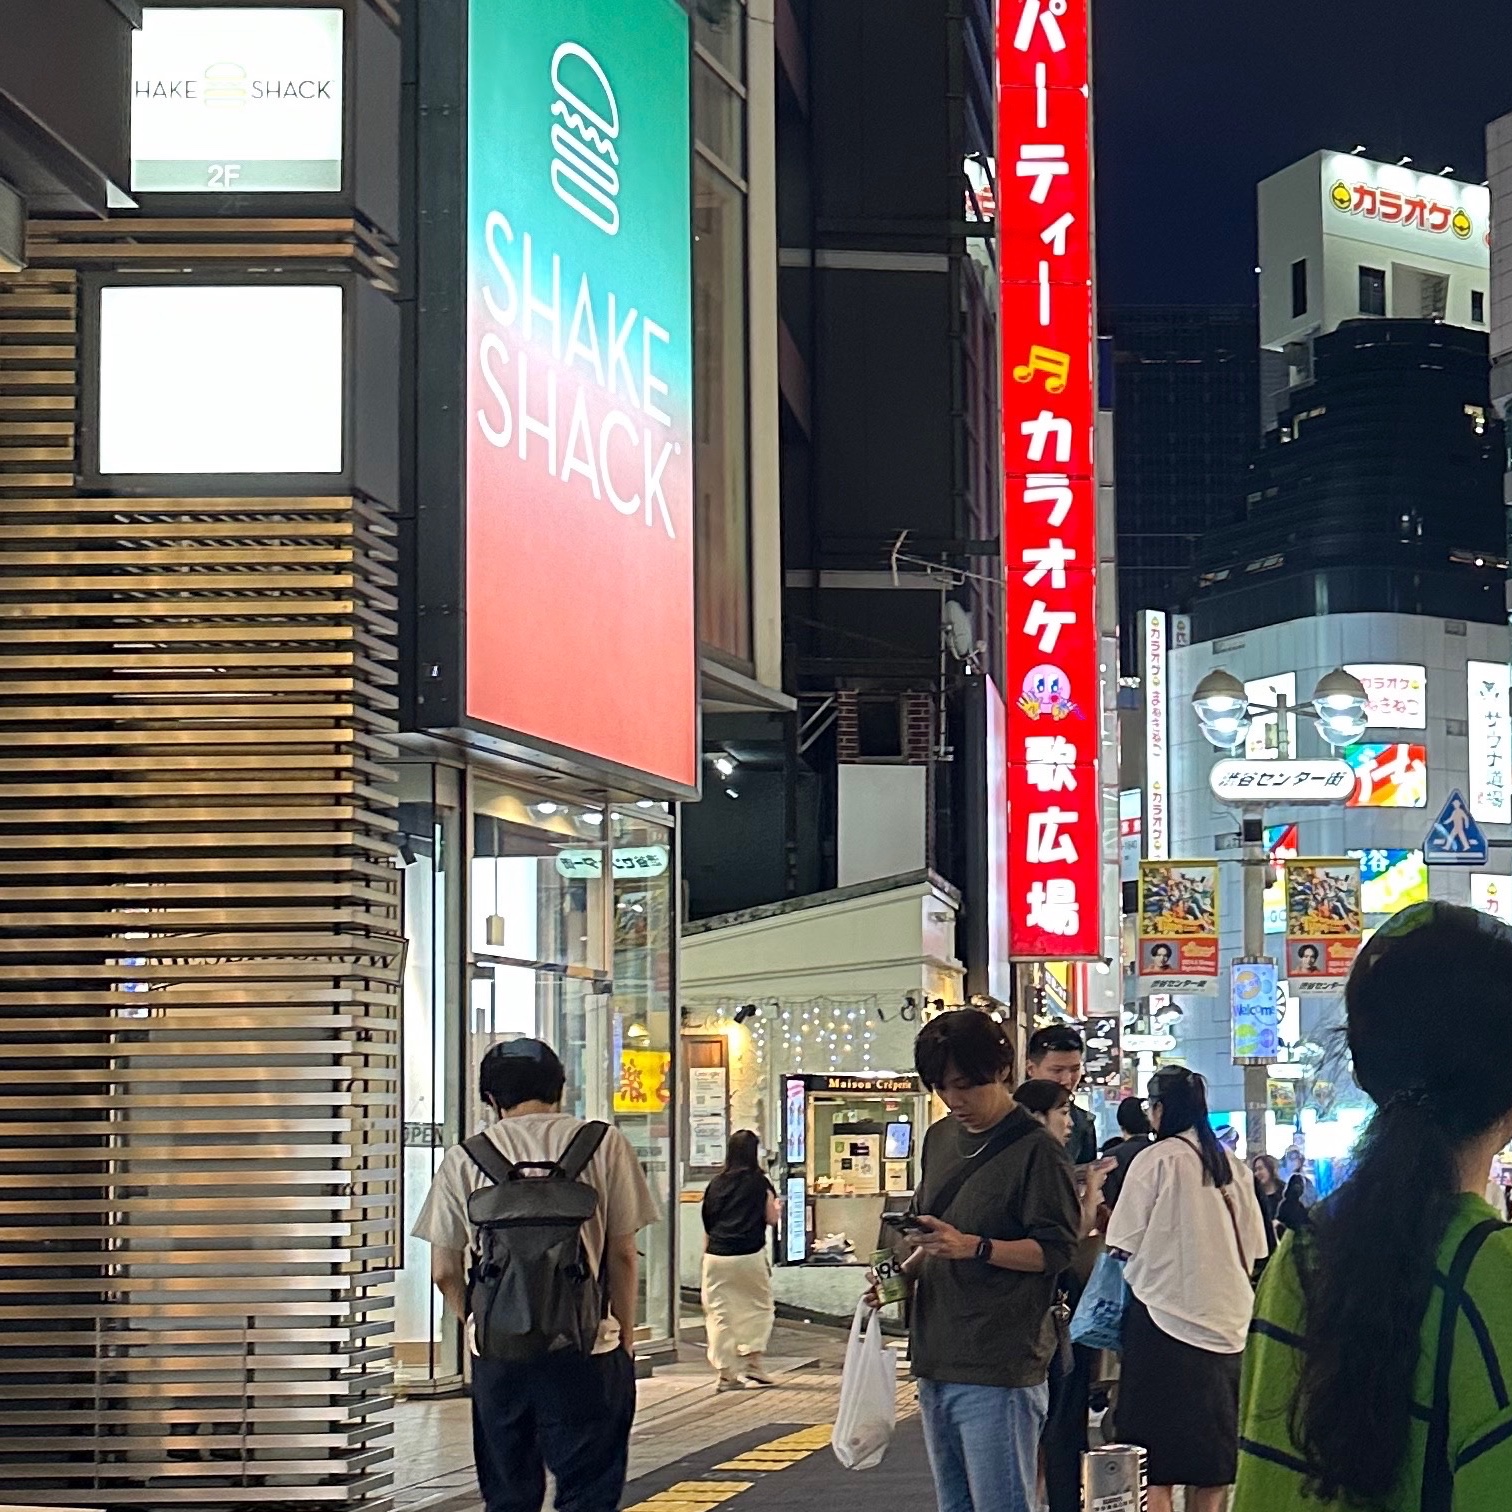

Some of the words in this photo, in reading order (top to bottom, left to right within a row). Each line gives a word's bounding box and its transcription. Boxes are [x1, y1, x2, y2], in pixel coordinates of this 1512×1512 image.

[135, 80, 197, 99] HAKE
[251, 80, 334, 99] SHACK
[207, 164, 241, 188] 2F
[1013, 0, 1075, 326] パーティー
[1353, 183, 1452, 232] カラオケ
[481, 210, 671, 427] SHAKE
[477, 332, 678, 539] SHACK
[1020, 410, 1077, 654] カラオケ
[1363, 697, 1420, 716] ねきねこ
[1218, 769, 1348, 787] 渋谷センター街
[1025, 734, 1080, 937] 歌広場
[1299, 981, 1346, 990] 渋谷センター
[828, 1078, 872, 1089] Maison
